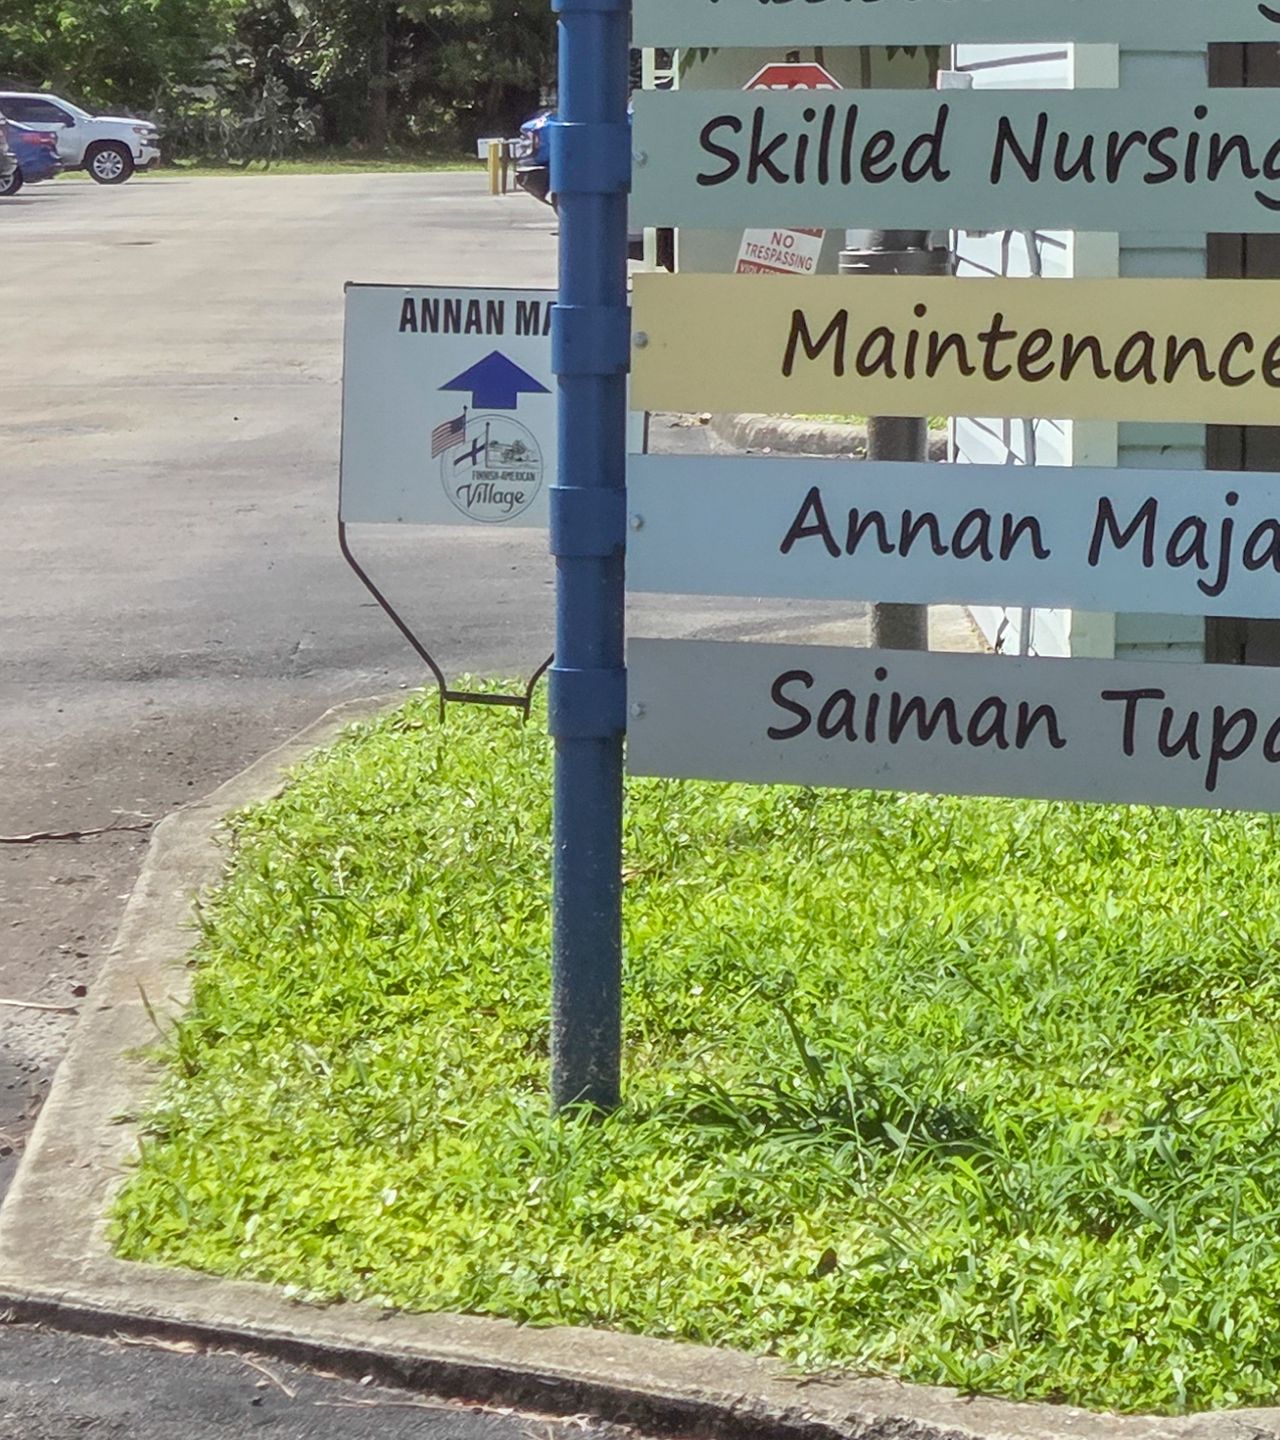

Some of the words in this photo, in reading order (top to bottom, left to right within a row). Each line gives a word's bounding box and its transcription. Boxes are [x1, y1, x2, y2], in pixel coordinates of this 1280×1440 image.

[696, 103, 951, 186] Skilled
[745, 242, 814, 271] TRESPASSING
[771, 231, 795, 249] NO
[399, 297, 505, 335] ANNAN
[456, 482, 525, 513] Village
[779, 486, 1051, 562] Annan
[766, 666, 1067, 750] Saiman
